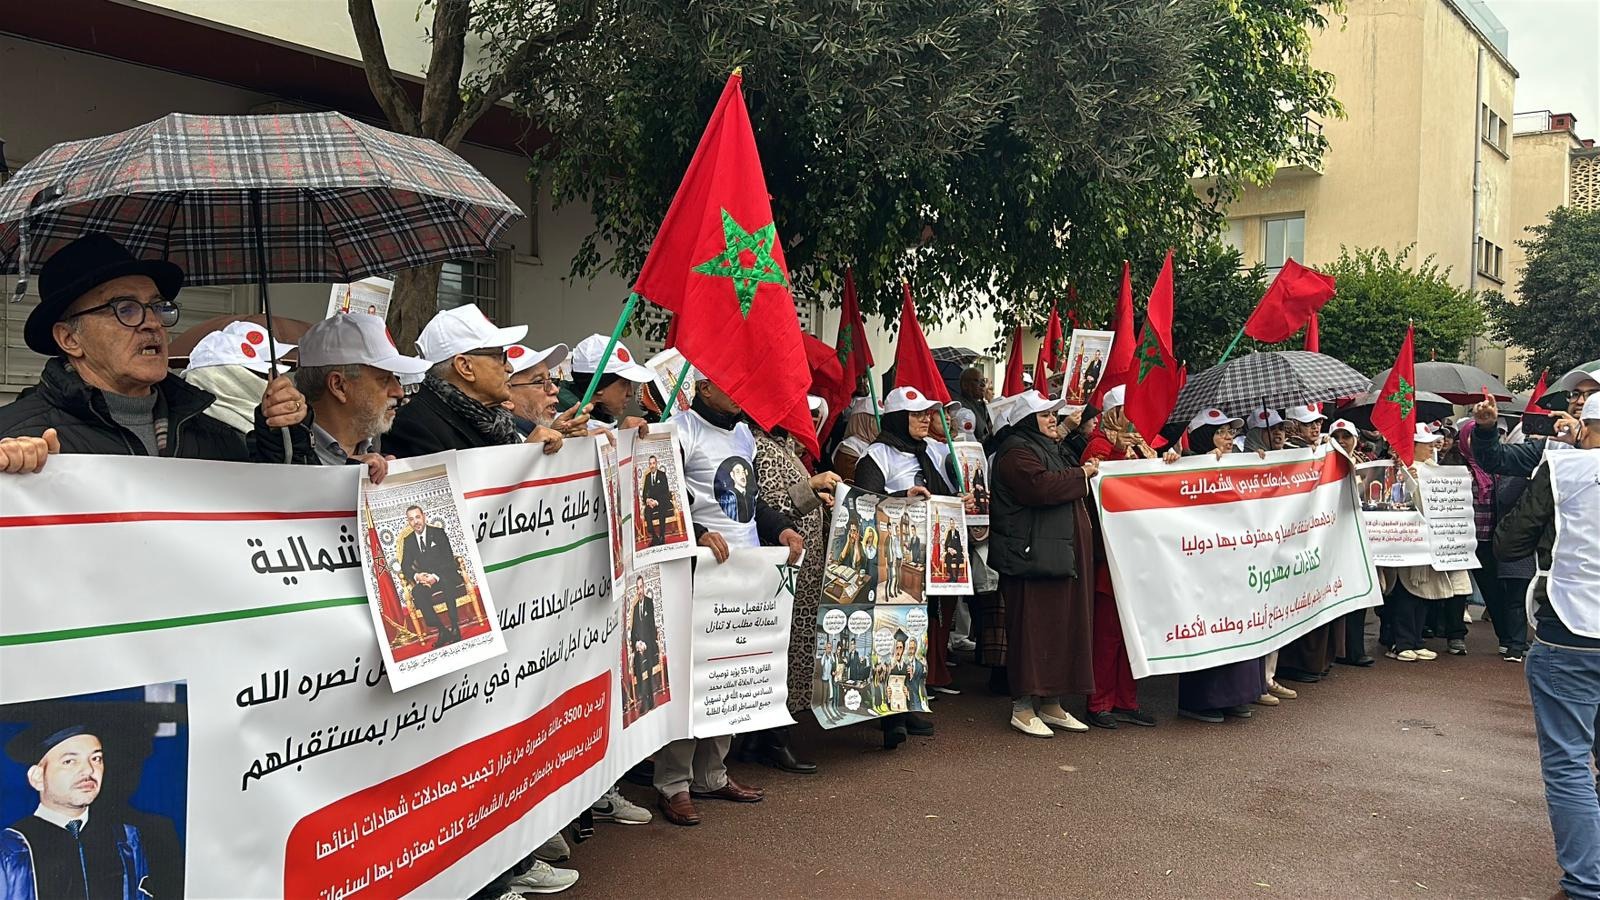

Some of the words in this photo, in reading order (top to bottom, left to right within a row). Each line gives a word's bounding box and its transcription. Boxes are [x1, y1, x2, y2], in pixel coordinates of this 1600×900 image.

[1180, 473, 1234, 500] الشمالية
[1235, 474, 1260, 494] قبرص
[1261, 472, 1290, 488] جامعات
[489, 499, 554, 539] جامعات
[561, 490, 590, 530] طلبة
[1182, 535, 1213, 556] دوليا
[1216, 532, 1237, 550] بها
[1240, 529, 1273, 548] معترف
[1275, 531, 1280, 544] و
[247, 525, 361, 586] شمالية
[1294, 547, 1321, 576] كفاءات
[1248, 564, 1290, 594] مهدورة
[530, 588, 569, 620] الجلالة
[570, 579, 596, 611] صاحب
[742, 602, 763, 615] تفعيل
[714, 603, 740, 616] مسطرة
[754, 616, 778, 627] المعادلة
[1247, 603, 1268, 630] أبناء
[705, 620, 725, 633] تنازل
[725, 620, 731, 629] لا
[732, 619, 753, 631] مطلب
[1166, 614, 1206, 642] الأكفاء
[1211, 617, 1244, 634] وطنه
[583, 627, 599, 650] من
[735, 636, 747, 644] عنه
[236, 669, 289, 708] الله
[297, 657, 361, 701] نصره
[484, 662, 510, 704] في
[432, 674, 479, 723] مشكل
[584, 702, 593, 718] من
[391, 702, 428, 741] يضر
[563, 704, 583, 725] 3500
[241, 719, 388, 791] بمستقبلهم
[496, 750, 512, 776] قرار
[513, 747, 524, 765] من
[555, 742, 584, 769] يدرسون
[461, 759, 494, 789] تجميد
[529, 760, 554, 787] بجامعات
[412, 780, 457, 810] معادلات
[504, 777, 529, 807] قبرص
[362, 795, 409, 836] شهادات
[466, 792, 504, 830] الشمالية
[316, 822, 358, 860] ابنائها
[437, 817, 464, 846] كانت
[397, 839, 435, 868] معترف
[374, 861, 394, 881] بها
